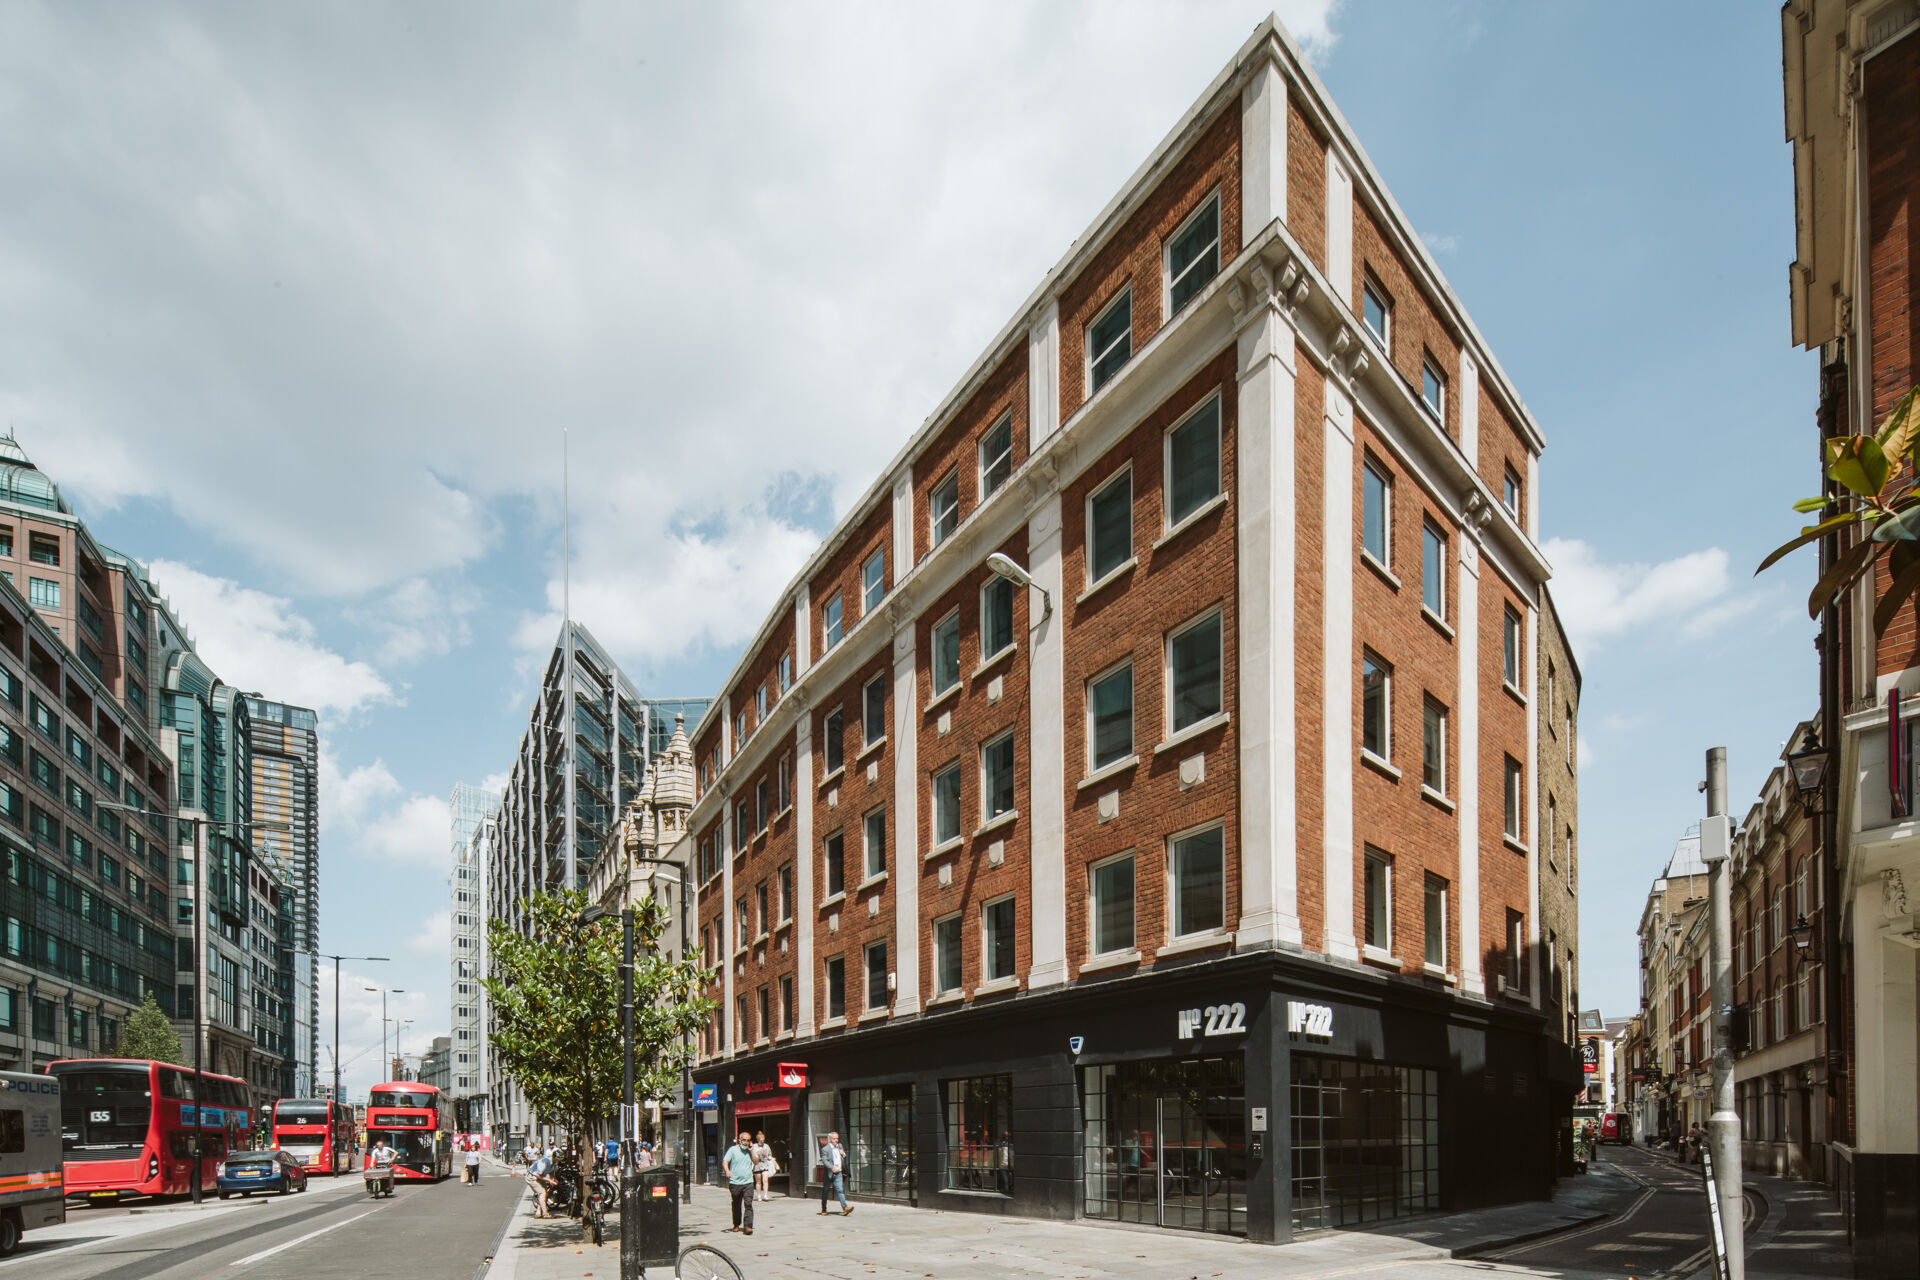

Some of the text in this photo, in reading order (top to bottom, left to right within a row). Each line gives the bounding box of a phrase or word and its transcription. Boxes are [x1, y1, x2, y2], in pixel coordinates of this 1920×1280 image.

[1204, 1002, 1247, 1037] 222
[1305, 1004, 1333, 1037] 222
[7, 1079, 59, 1095] POLICE
[90, 1110, 111, 1122] 135
[296, 1117, 307, 1125] 26
